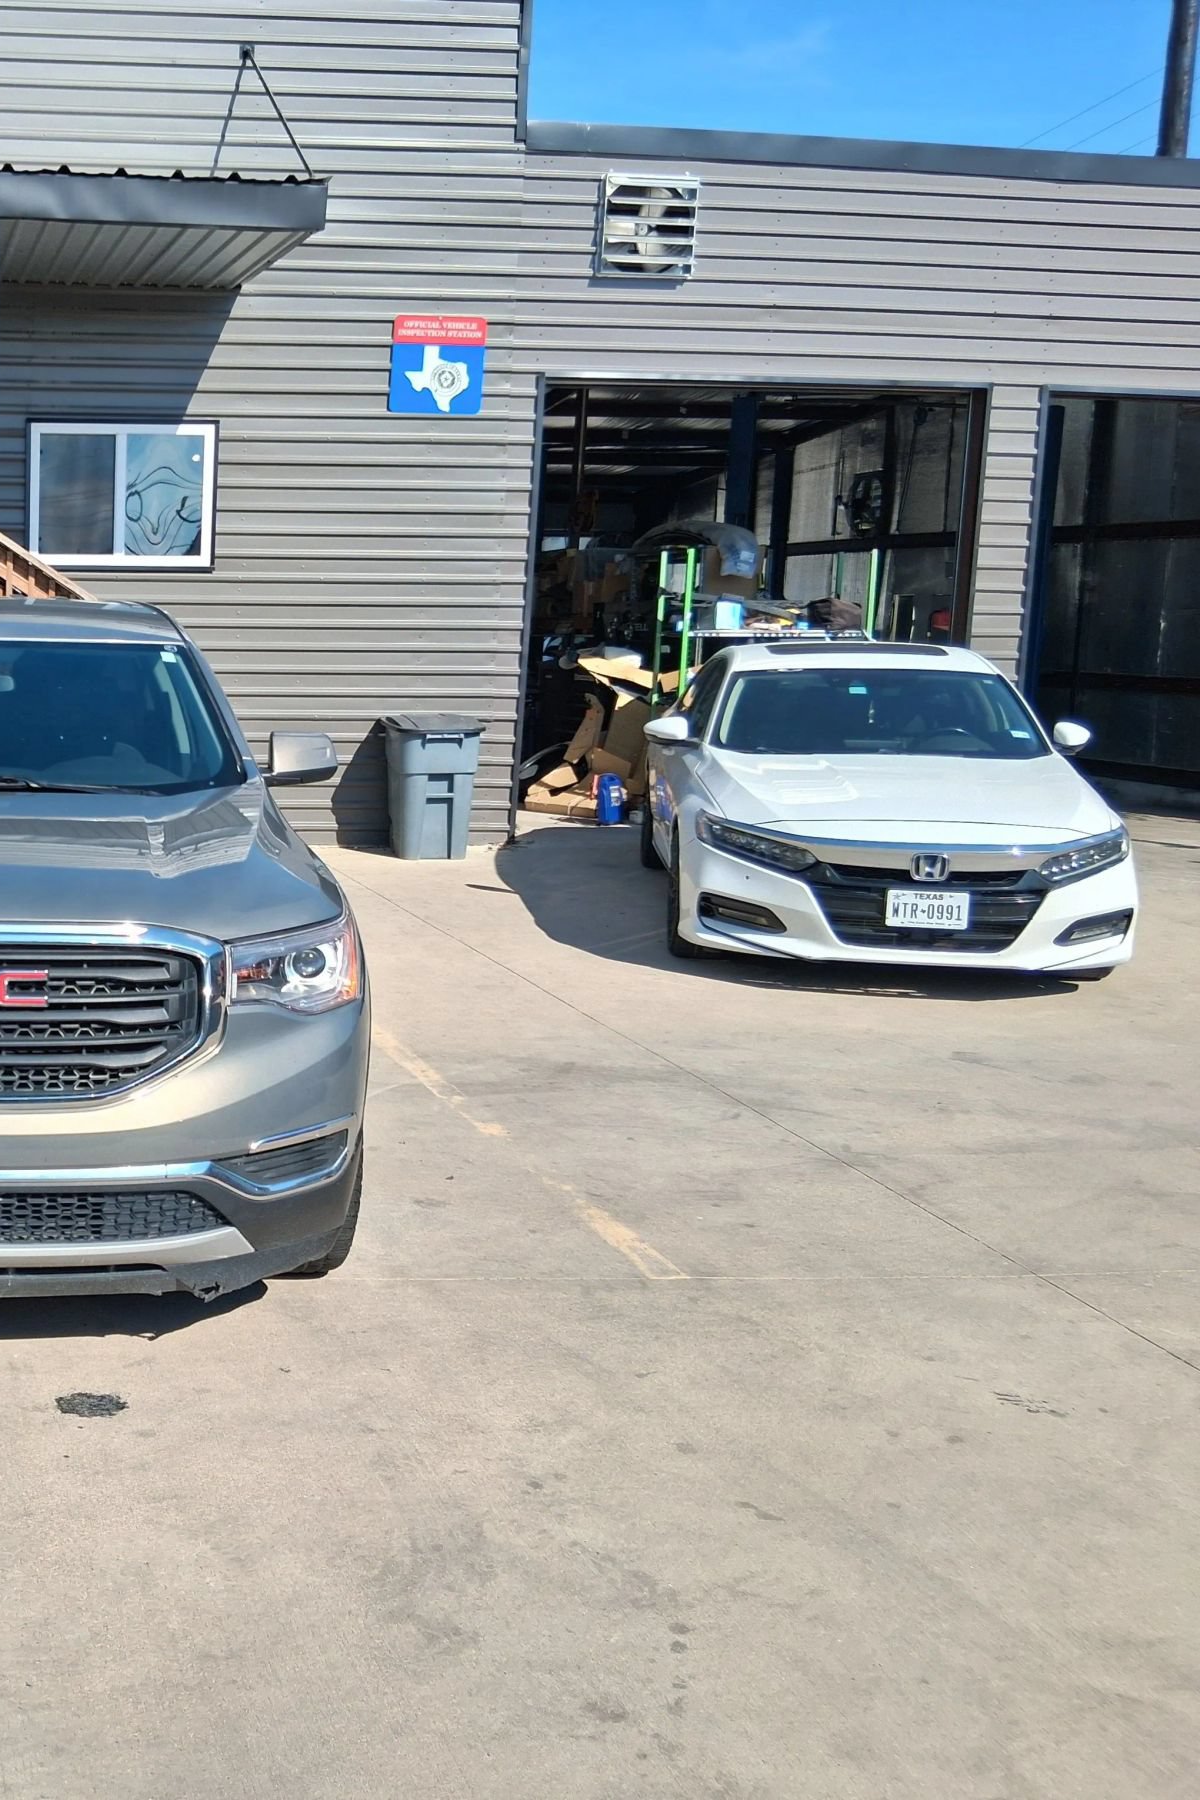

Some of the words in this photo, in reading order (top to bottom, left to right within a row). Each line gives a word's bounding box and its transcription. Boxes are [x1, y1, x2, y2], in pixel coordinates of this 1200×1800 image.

[403, 320, 441, 329] OFFICIAL
[442, 322, 478, 330] VEHICLE
[398, 328, 445, 337] INSPECTION
[446, 330, 483, 339] STATION
[913, 893, 944, 901] TEXAS
